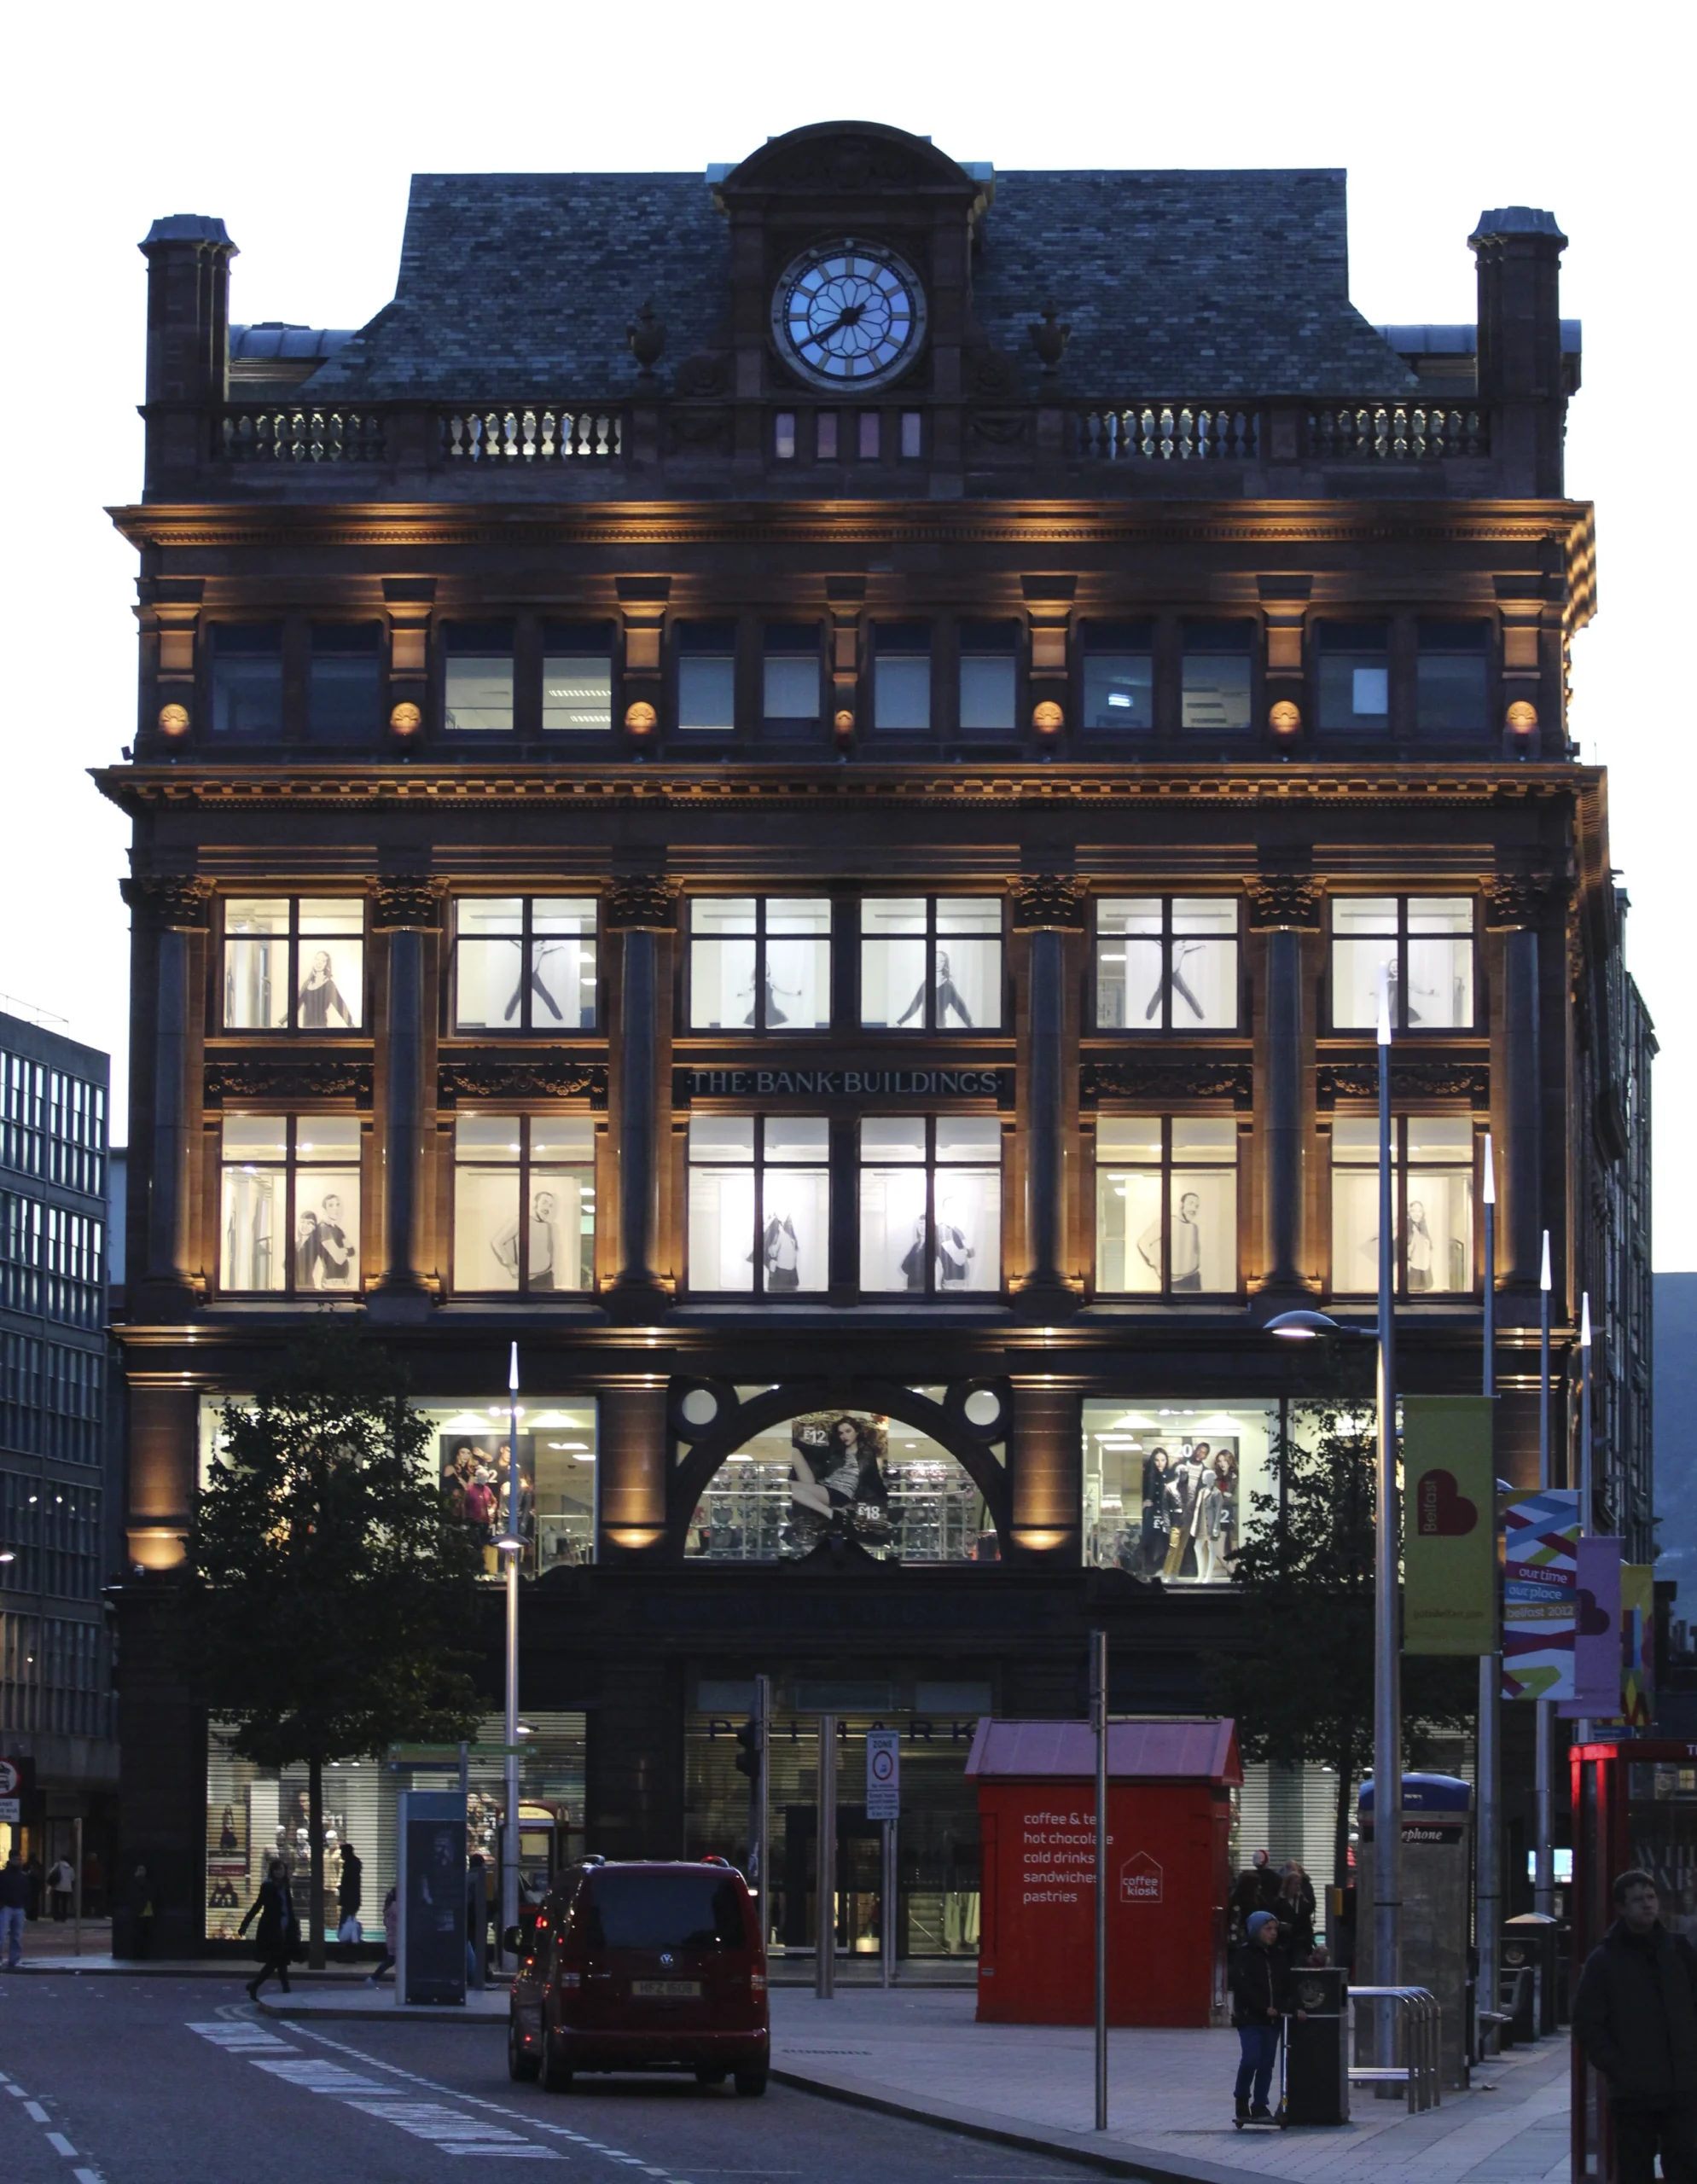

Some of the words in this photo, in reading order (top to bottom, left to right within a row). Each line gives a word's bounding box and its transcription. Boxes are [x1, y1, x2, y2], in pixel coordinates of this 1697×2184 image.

[1423, 1480, 1437, 1531] Belfast
[1519, 1568, 1539, 1578] our
[1540, 1570, 1567, 1583] time
[1508, 1586, 1529, 1596] our
[1530, 1587, 1562, 1600] place
[1548, 1606, 1573, 1617] 2012
[1024, 1812, 1066, 1825] coffee
[1069, 1812, 1081, 1825] &
[1024, 1832, 1047, 1844] hot
[1401, 1827, 1443, 1842] ephone
[1023, 1850, 1051, 1863] cold
[1054, 1850, 1095, 1863] drinks
[1122, 1875, 1159, 1886] coffee
[1023, 1890, 1078, 1904] pastries
[1127, 1885, 1159, 1896] kiosk
